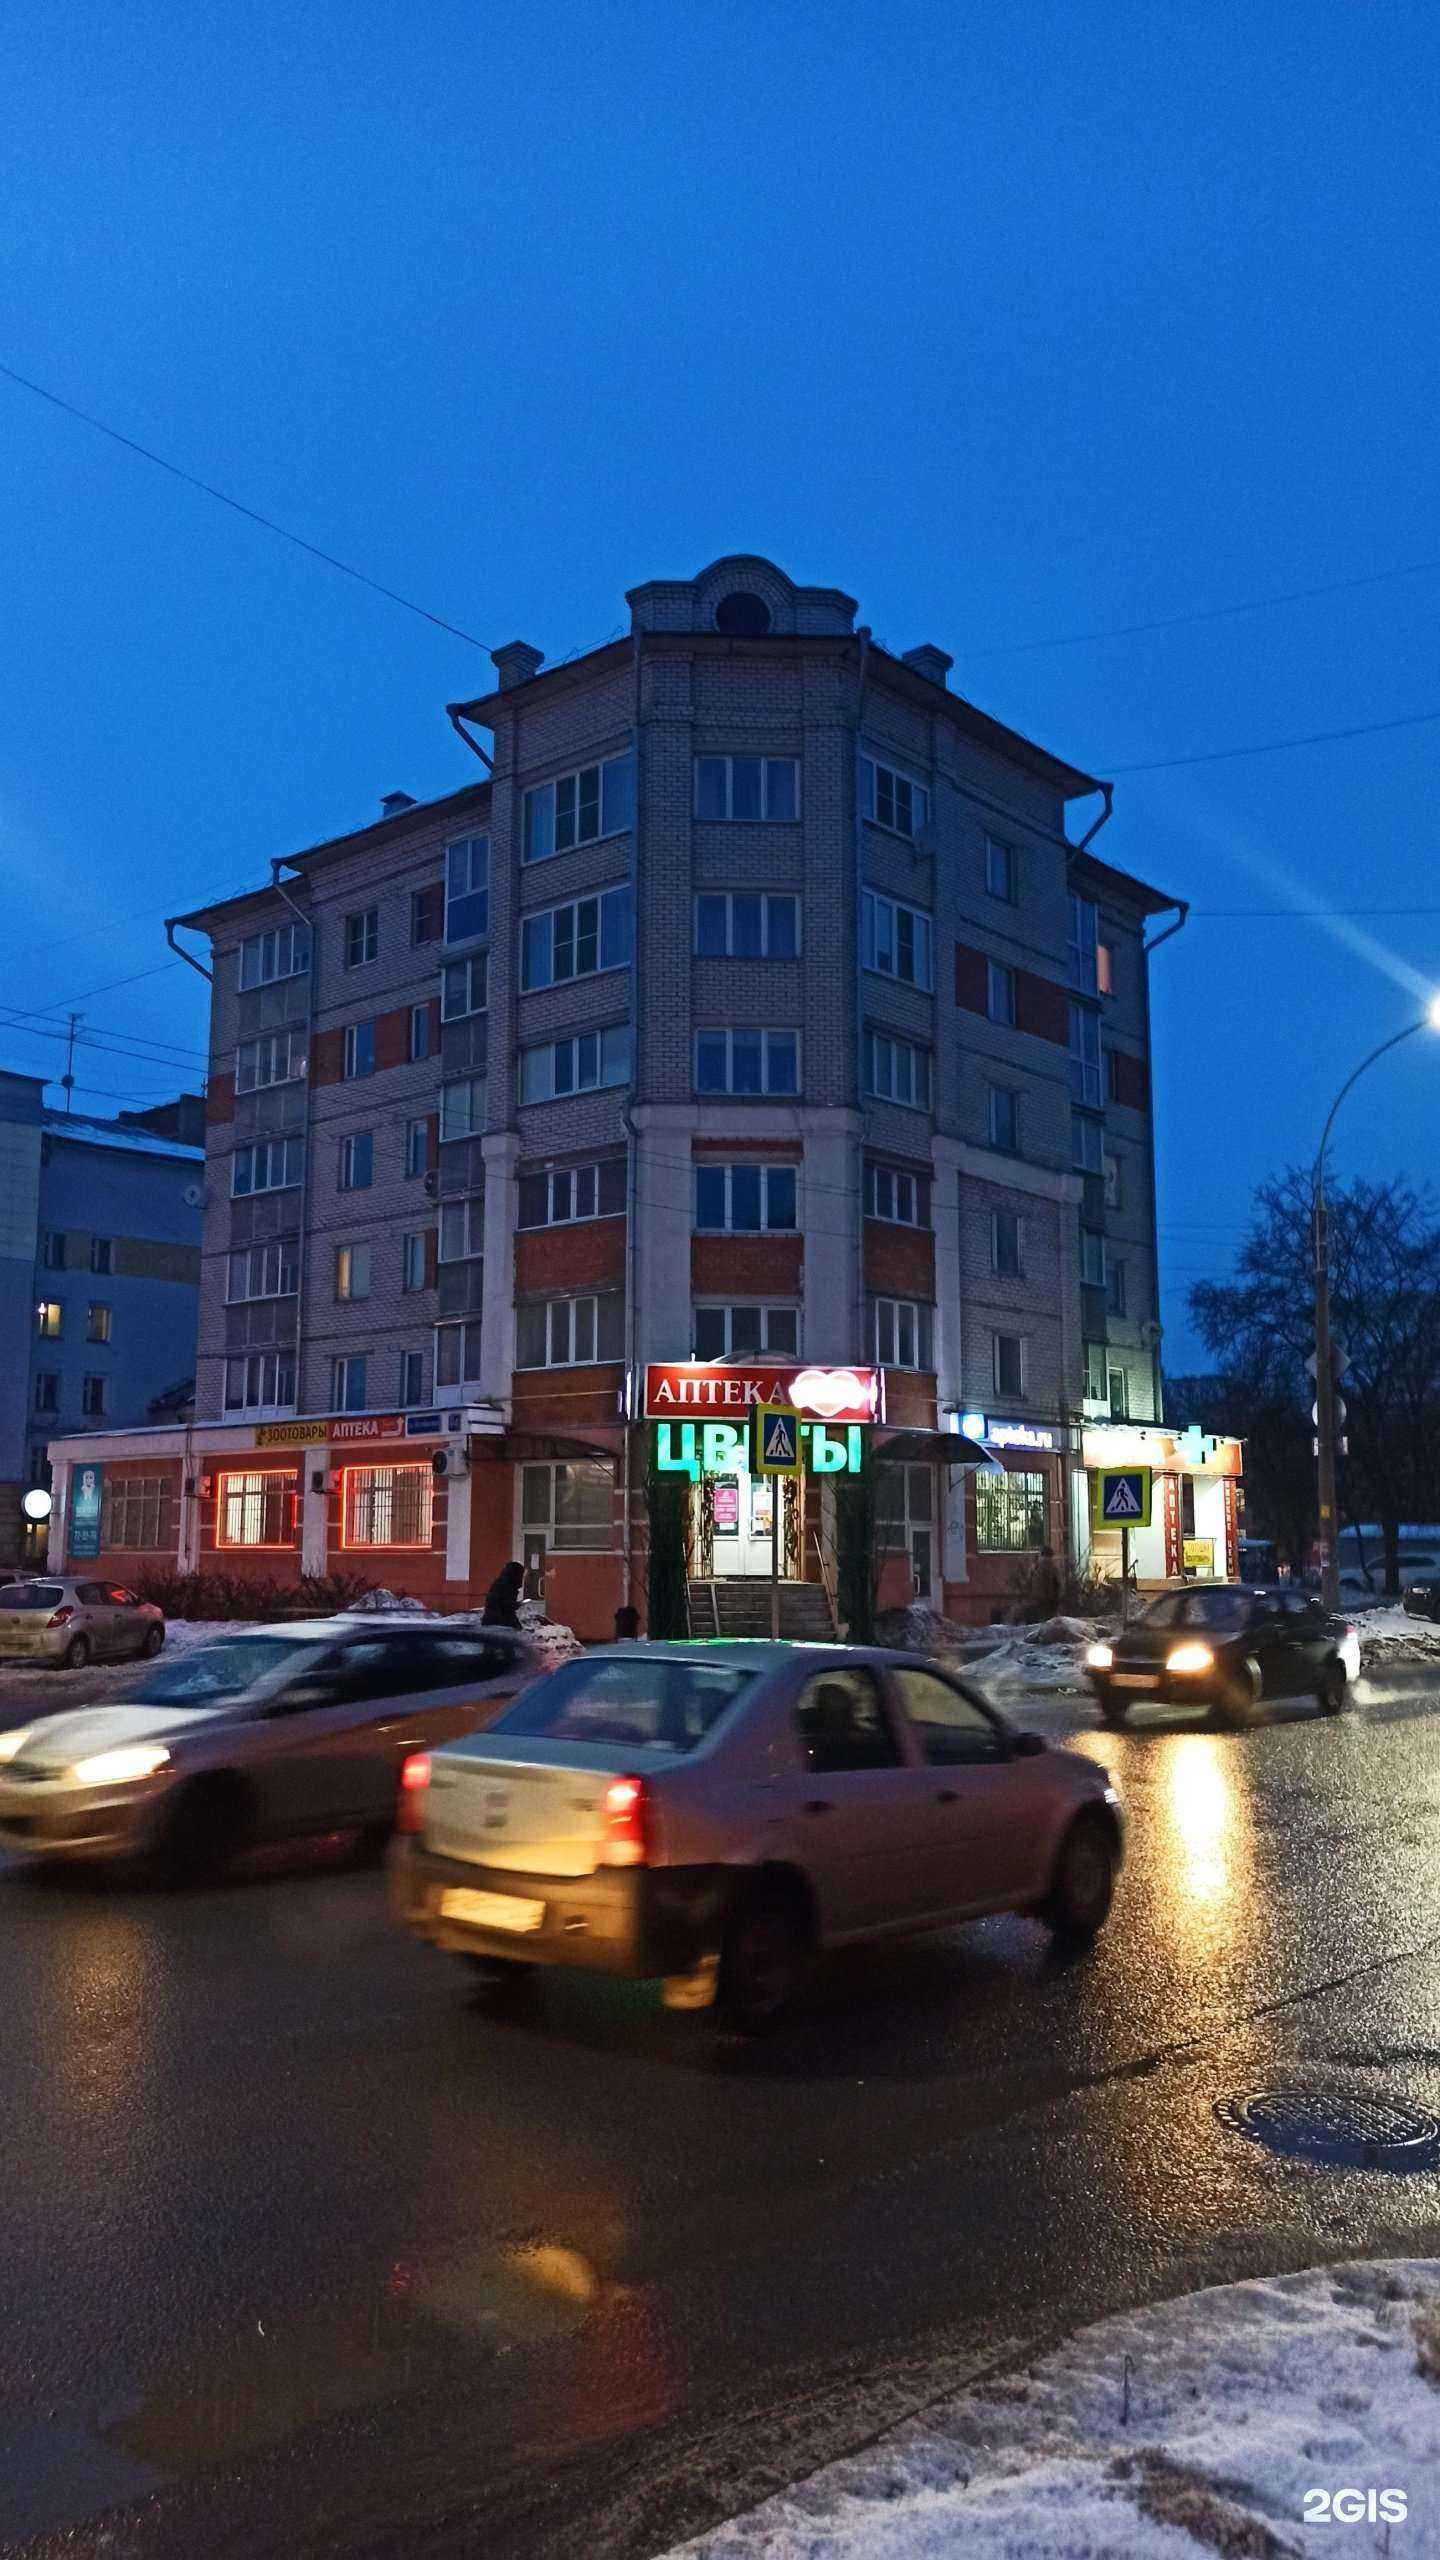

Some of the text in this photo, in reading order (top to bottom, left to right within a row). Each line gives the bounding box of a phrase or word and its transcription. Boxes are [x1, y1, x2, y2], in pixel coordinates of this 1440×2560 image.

[653, 1378, 792, 1406] АПТЕКА
[268, 1423, 326, 1442] ЗООТОВАРЫ
[332, 1420, 379, 1438] АПТЕКА
[657, 1423, 862, 1482] ЦВЫ
[1168, 1478, 1178, 1575] АПТЕКА
